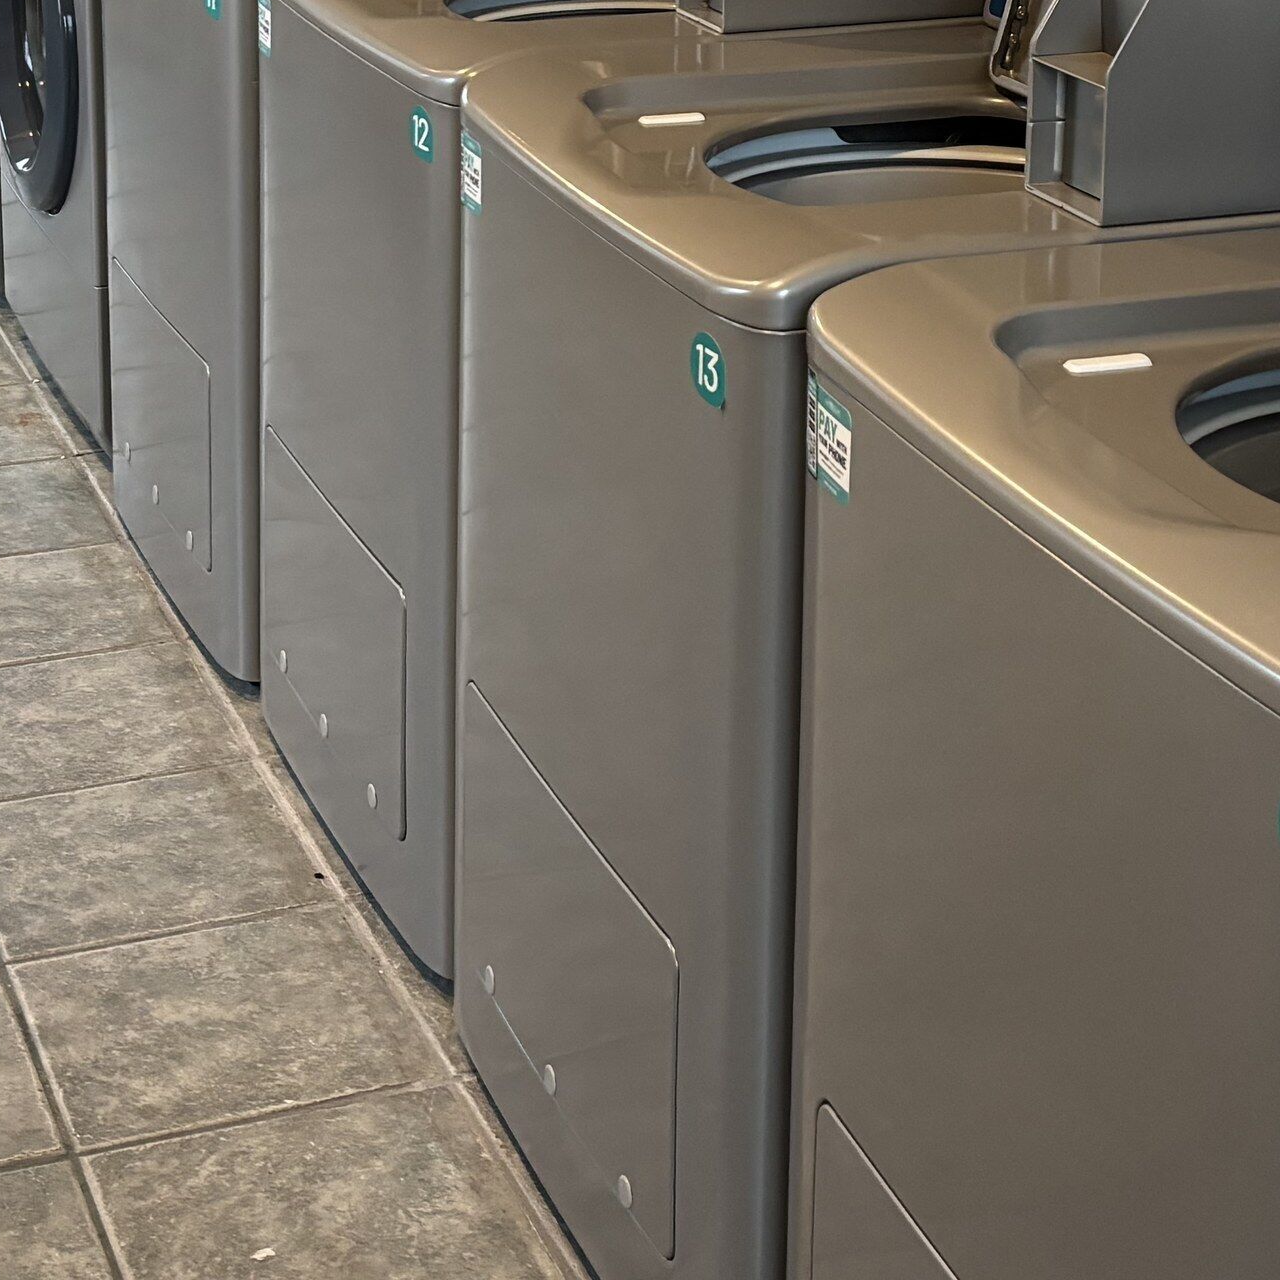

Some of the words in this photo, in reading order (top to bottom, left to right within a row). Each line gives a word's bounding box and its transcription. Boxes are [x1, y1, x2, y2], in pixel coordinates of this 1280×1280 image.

[413, 113, 430, 153] 12
[696, 343, 719, 393] 13
[819, 407, 838, 446] PAY
[828, 441, 847, 472] PHONE
